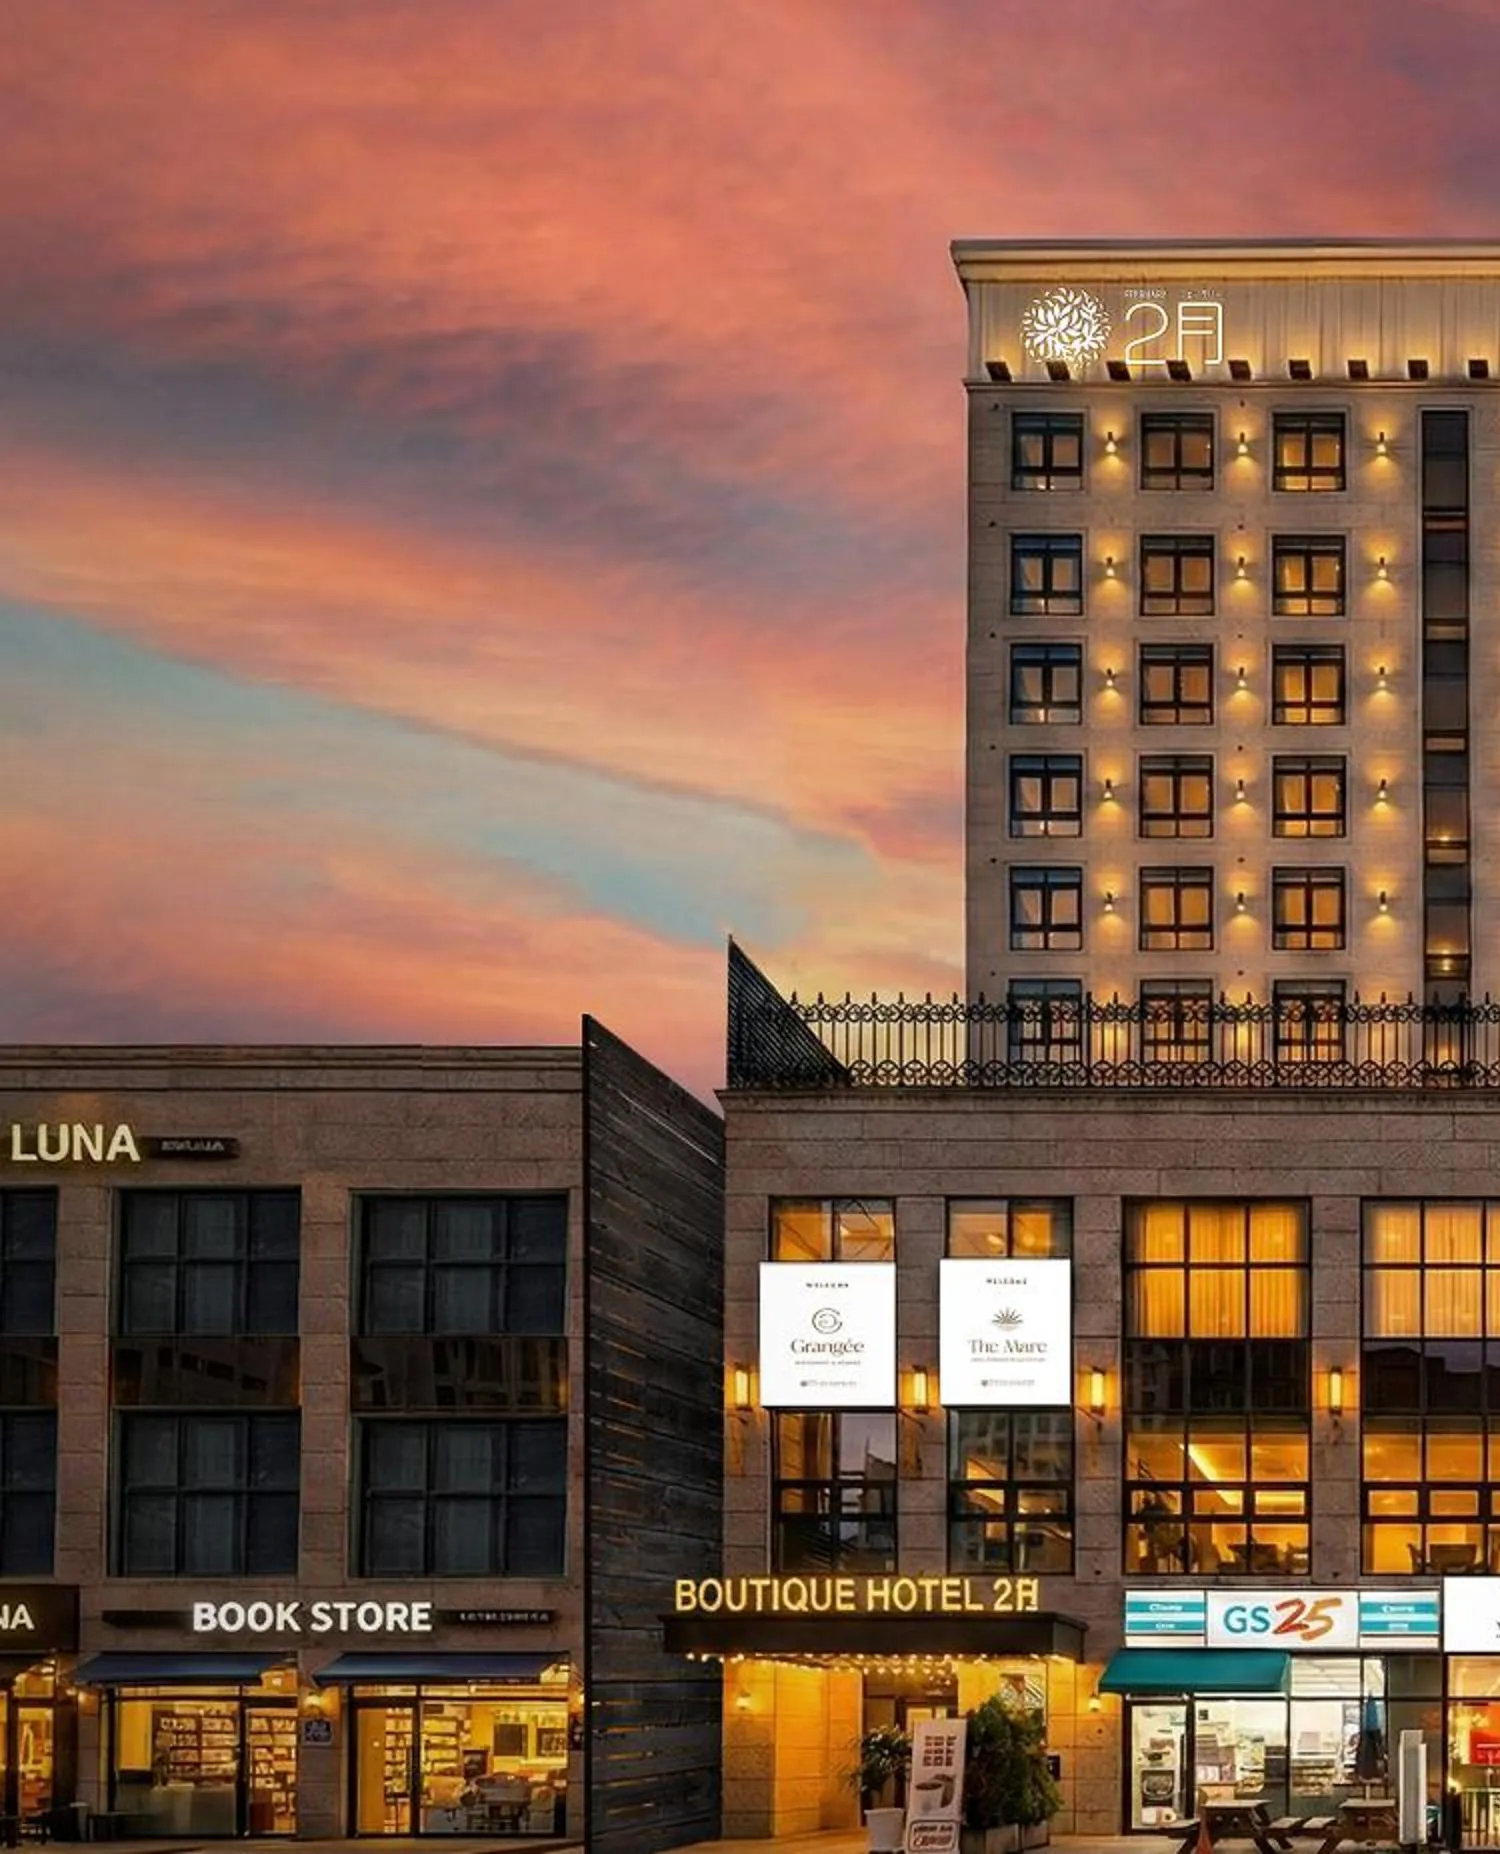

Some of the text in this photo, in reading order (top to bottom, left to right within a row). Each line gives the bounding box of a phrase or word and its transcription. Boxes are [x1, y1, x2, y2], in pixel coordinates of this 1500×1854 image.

[11, 1123, 141, 1162] LUNA
[969, 1339, 999, 1354] The
[675, 1578, 856, 1612] BOUTIQUE
[867, 1578, 984, 1612] HOTEL
[193, 1601, 432, 1632] BOOK STORE
